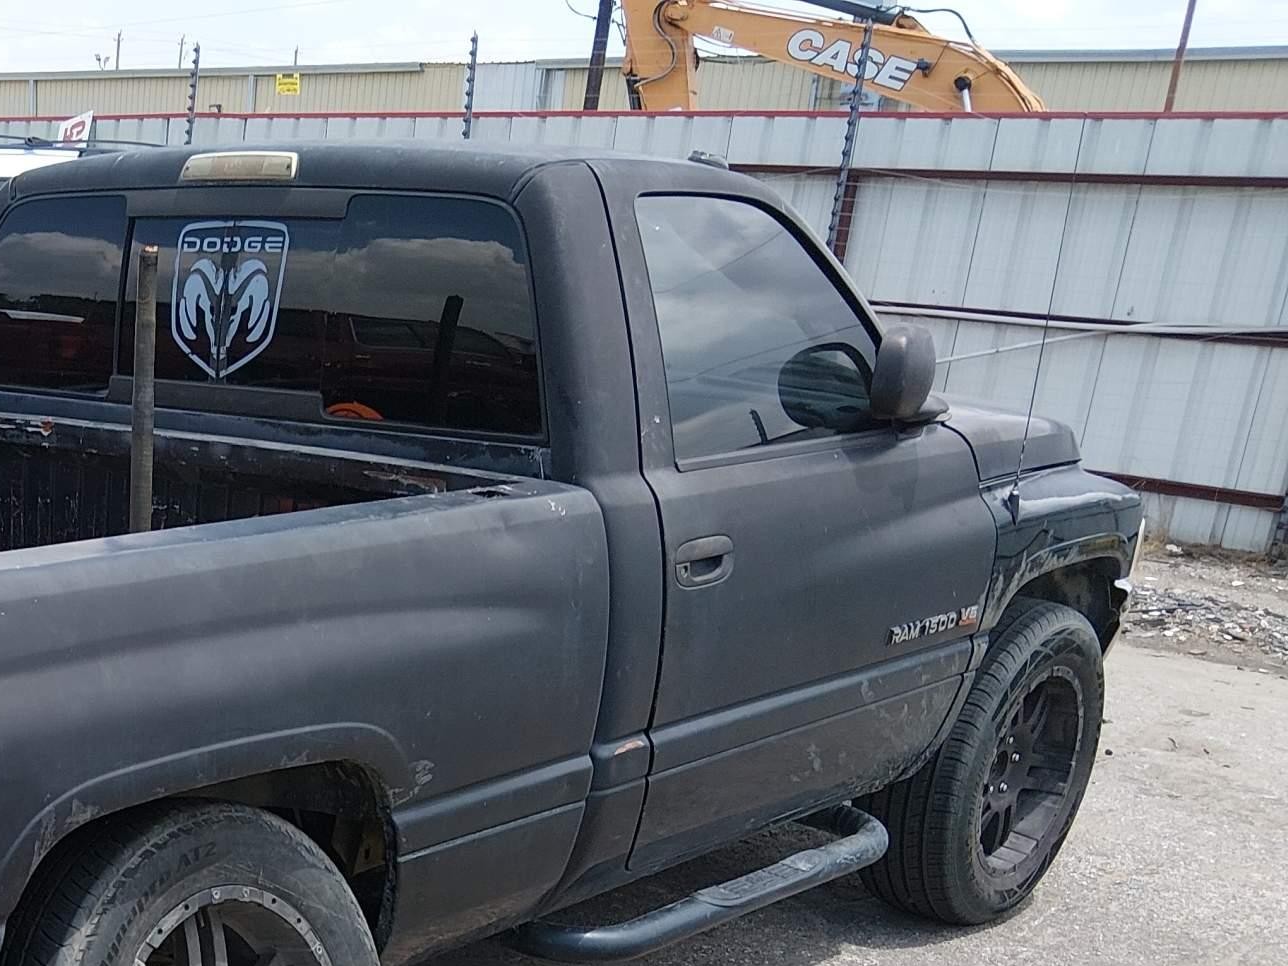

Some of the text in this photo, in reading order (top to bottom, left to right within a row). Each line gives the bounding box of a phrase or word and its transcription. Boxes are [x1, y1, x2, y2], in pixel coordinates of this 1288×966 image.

[787, 28, 918, 92] CASE
[183, 236, 284, 253] DODGE
[890, 620, 920, 645] RAM
[921, 611, 957, 636] 1500
